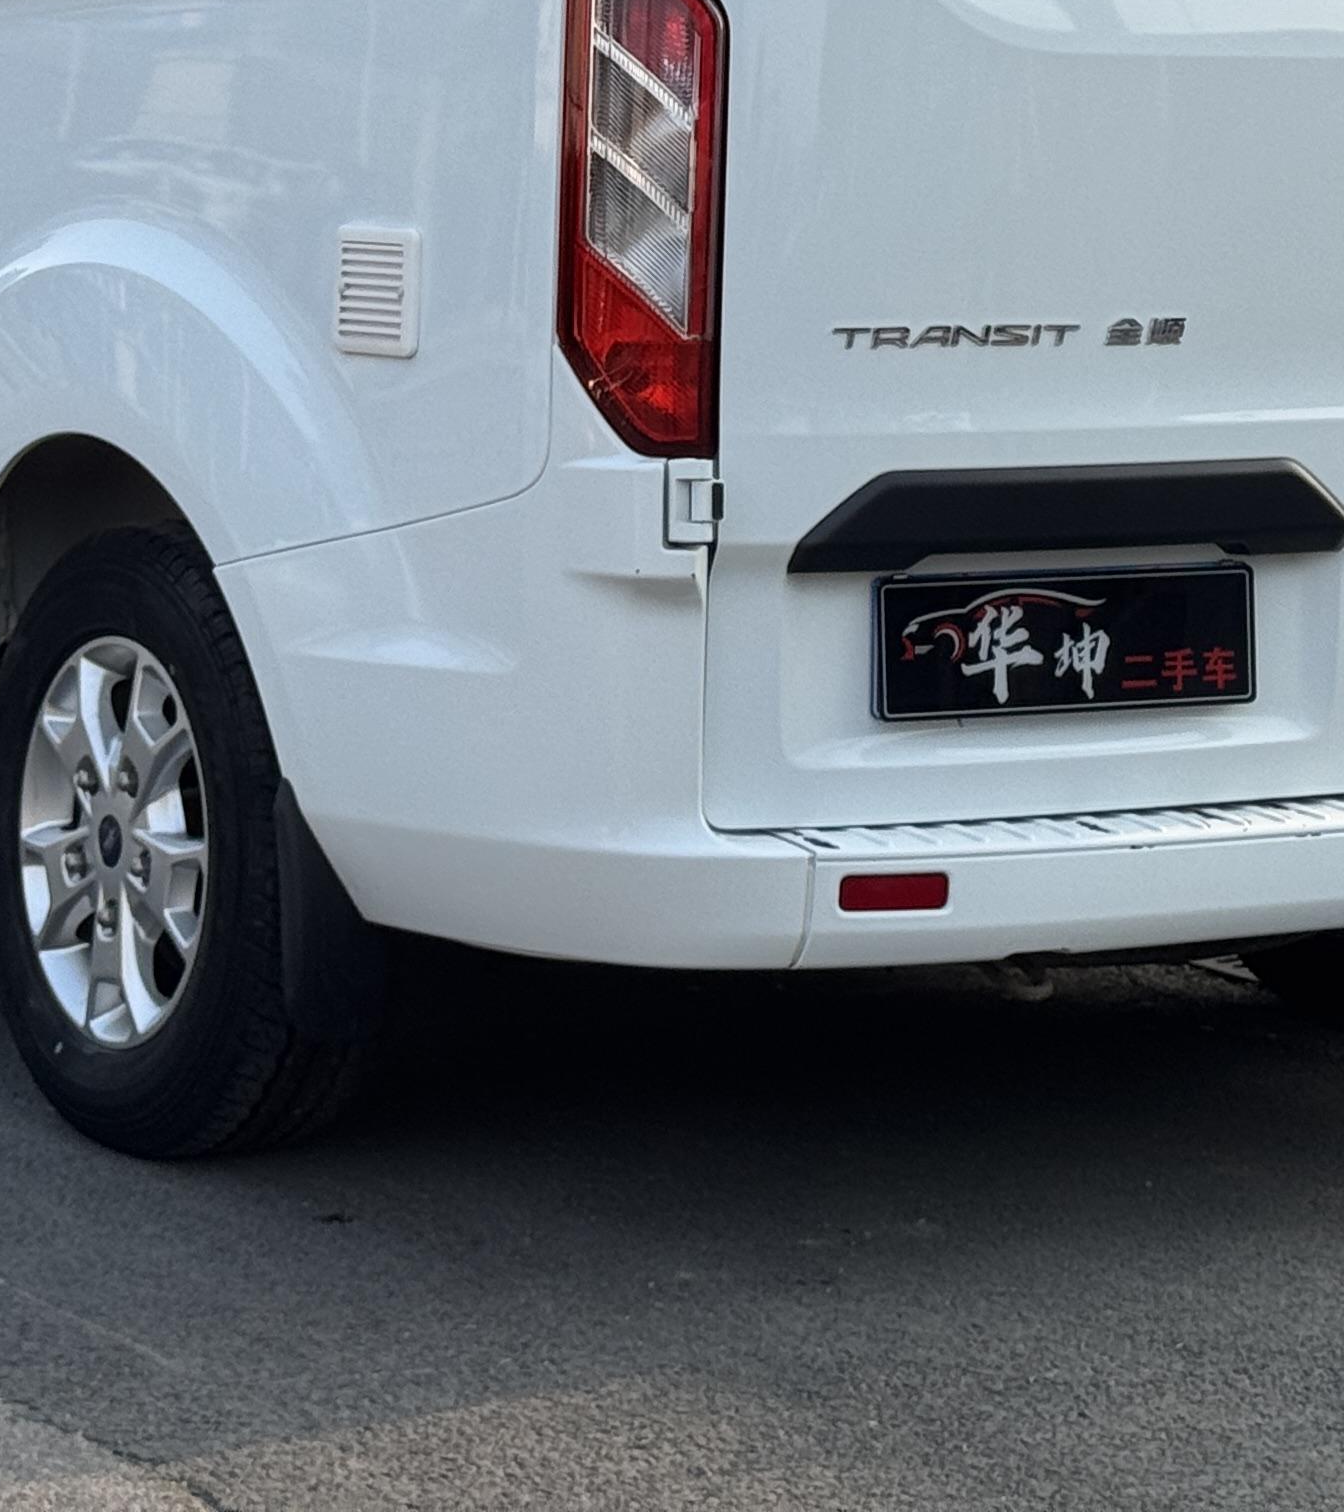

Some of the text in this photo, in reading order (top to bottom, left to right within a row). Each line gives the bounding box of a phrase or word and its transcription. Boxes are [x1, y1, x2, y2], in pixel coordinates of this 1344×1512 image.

[833, 323, 1081, 350] TRANSIT
[961, 604, 1237, 704] 华坤 二手车
